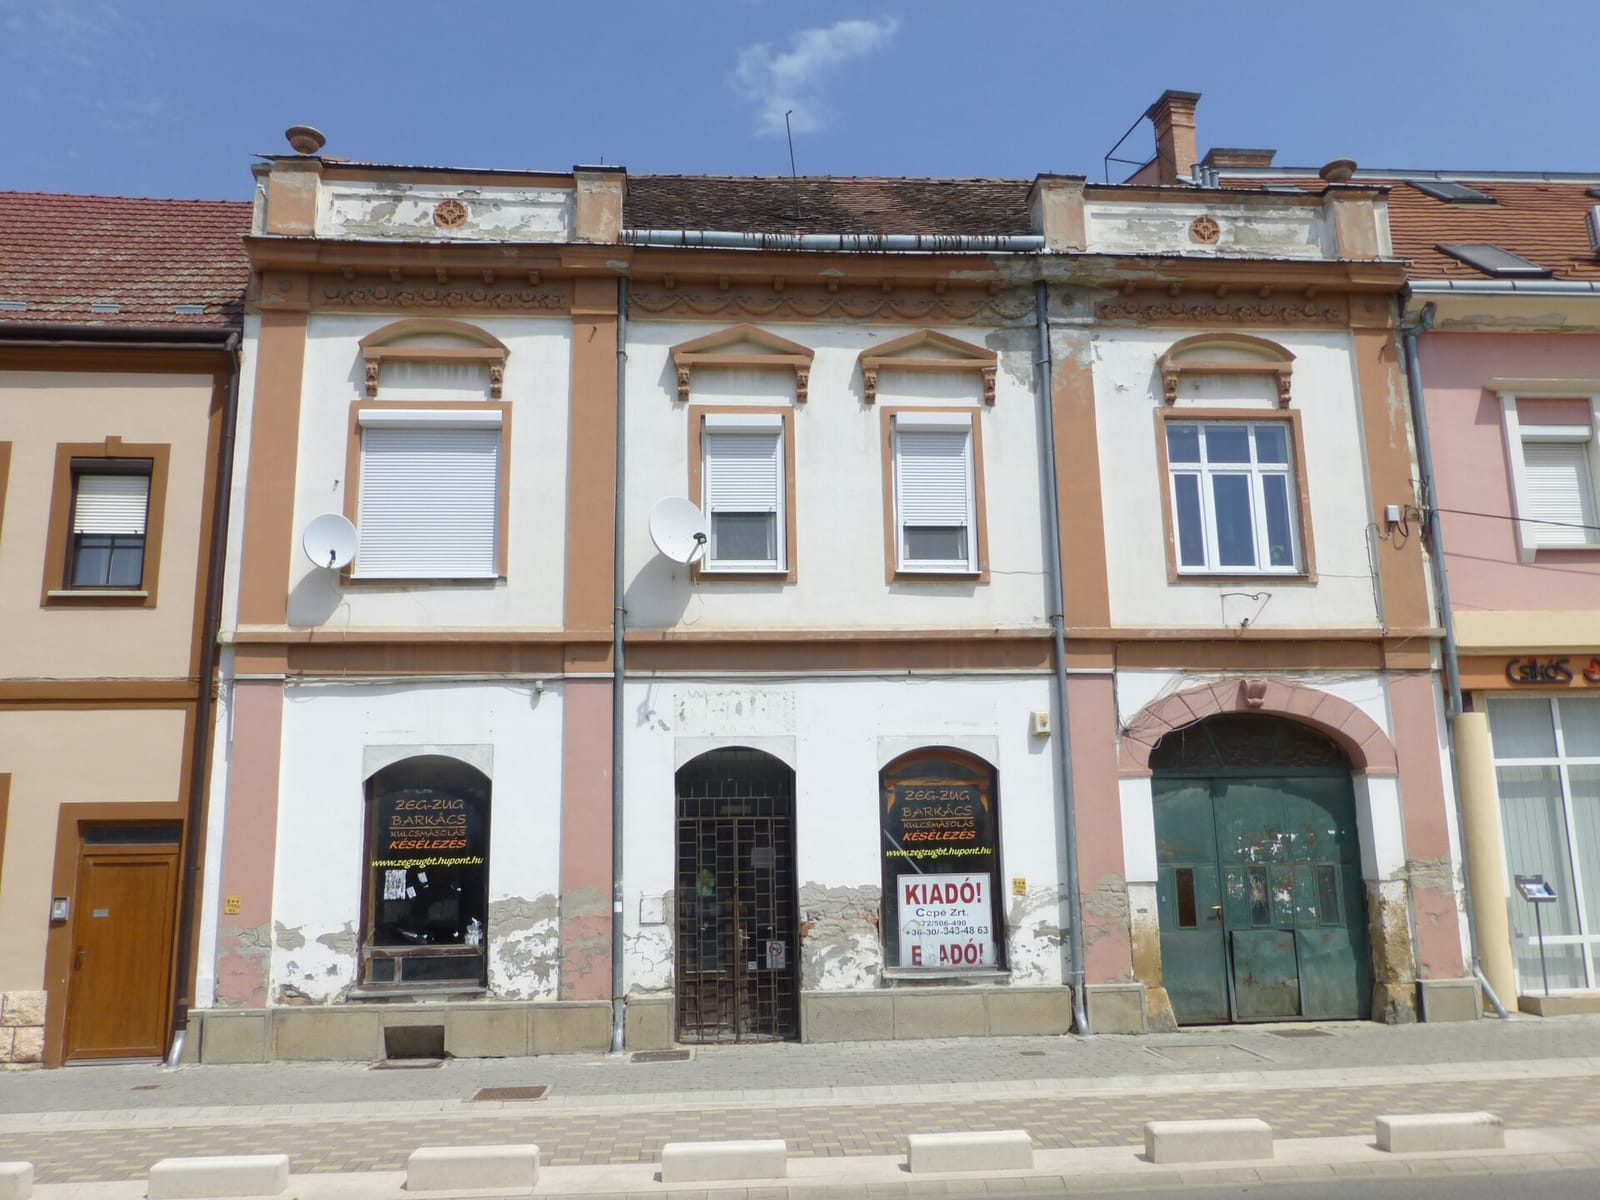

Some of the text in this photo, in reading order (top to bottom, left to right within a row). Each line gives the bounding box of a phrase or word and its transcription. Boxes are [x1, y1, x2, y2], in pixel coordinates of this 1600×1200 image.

[904, 790, 970, 801] ZEG-ZUG
[394, 799, 465, 811] ZEG-ZUG
[902, 803, 973, 817] BARKÁCS
[391, 812, 466, 826] BARKÁCS
[903, 828, 976, 841] KÉSÉLEZÉS
[389, 837, 468, 850] KÉSÉLEZÉS
[371, 855, 484, 869] www.zegzugbt.hupont.hu
[905, 877, 982, 905] KIADÓ!
[950, 908, 969, 917] Zrt.
[911, 937, 984, 966] EADÓ!
